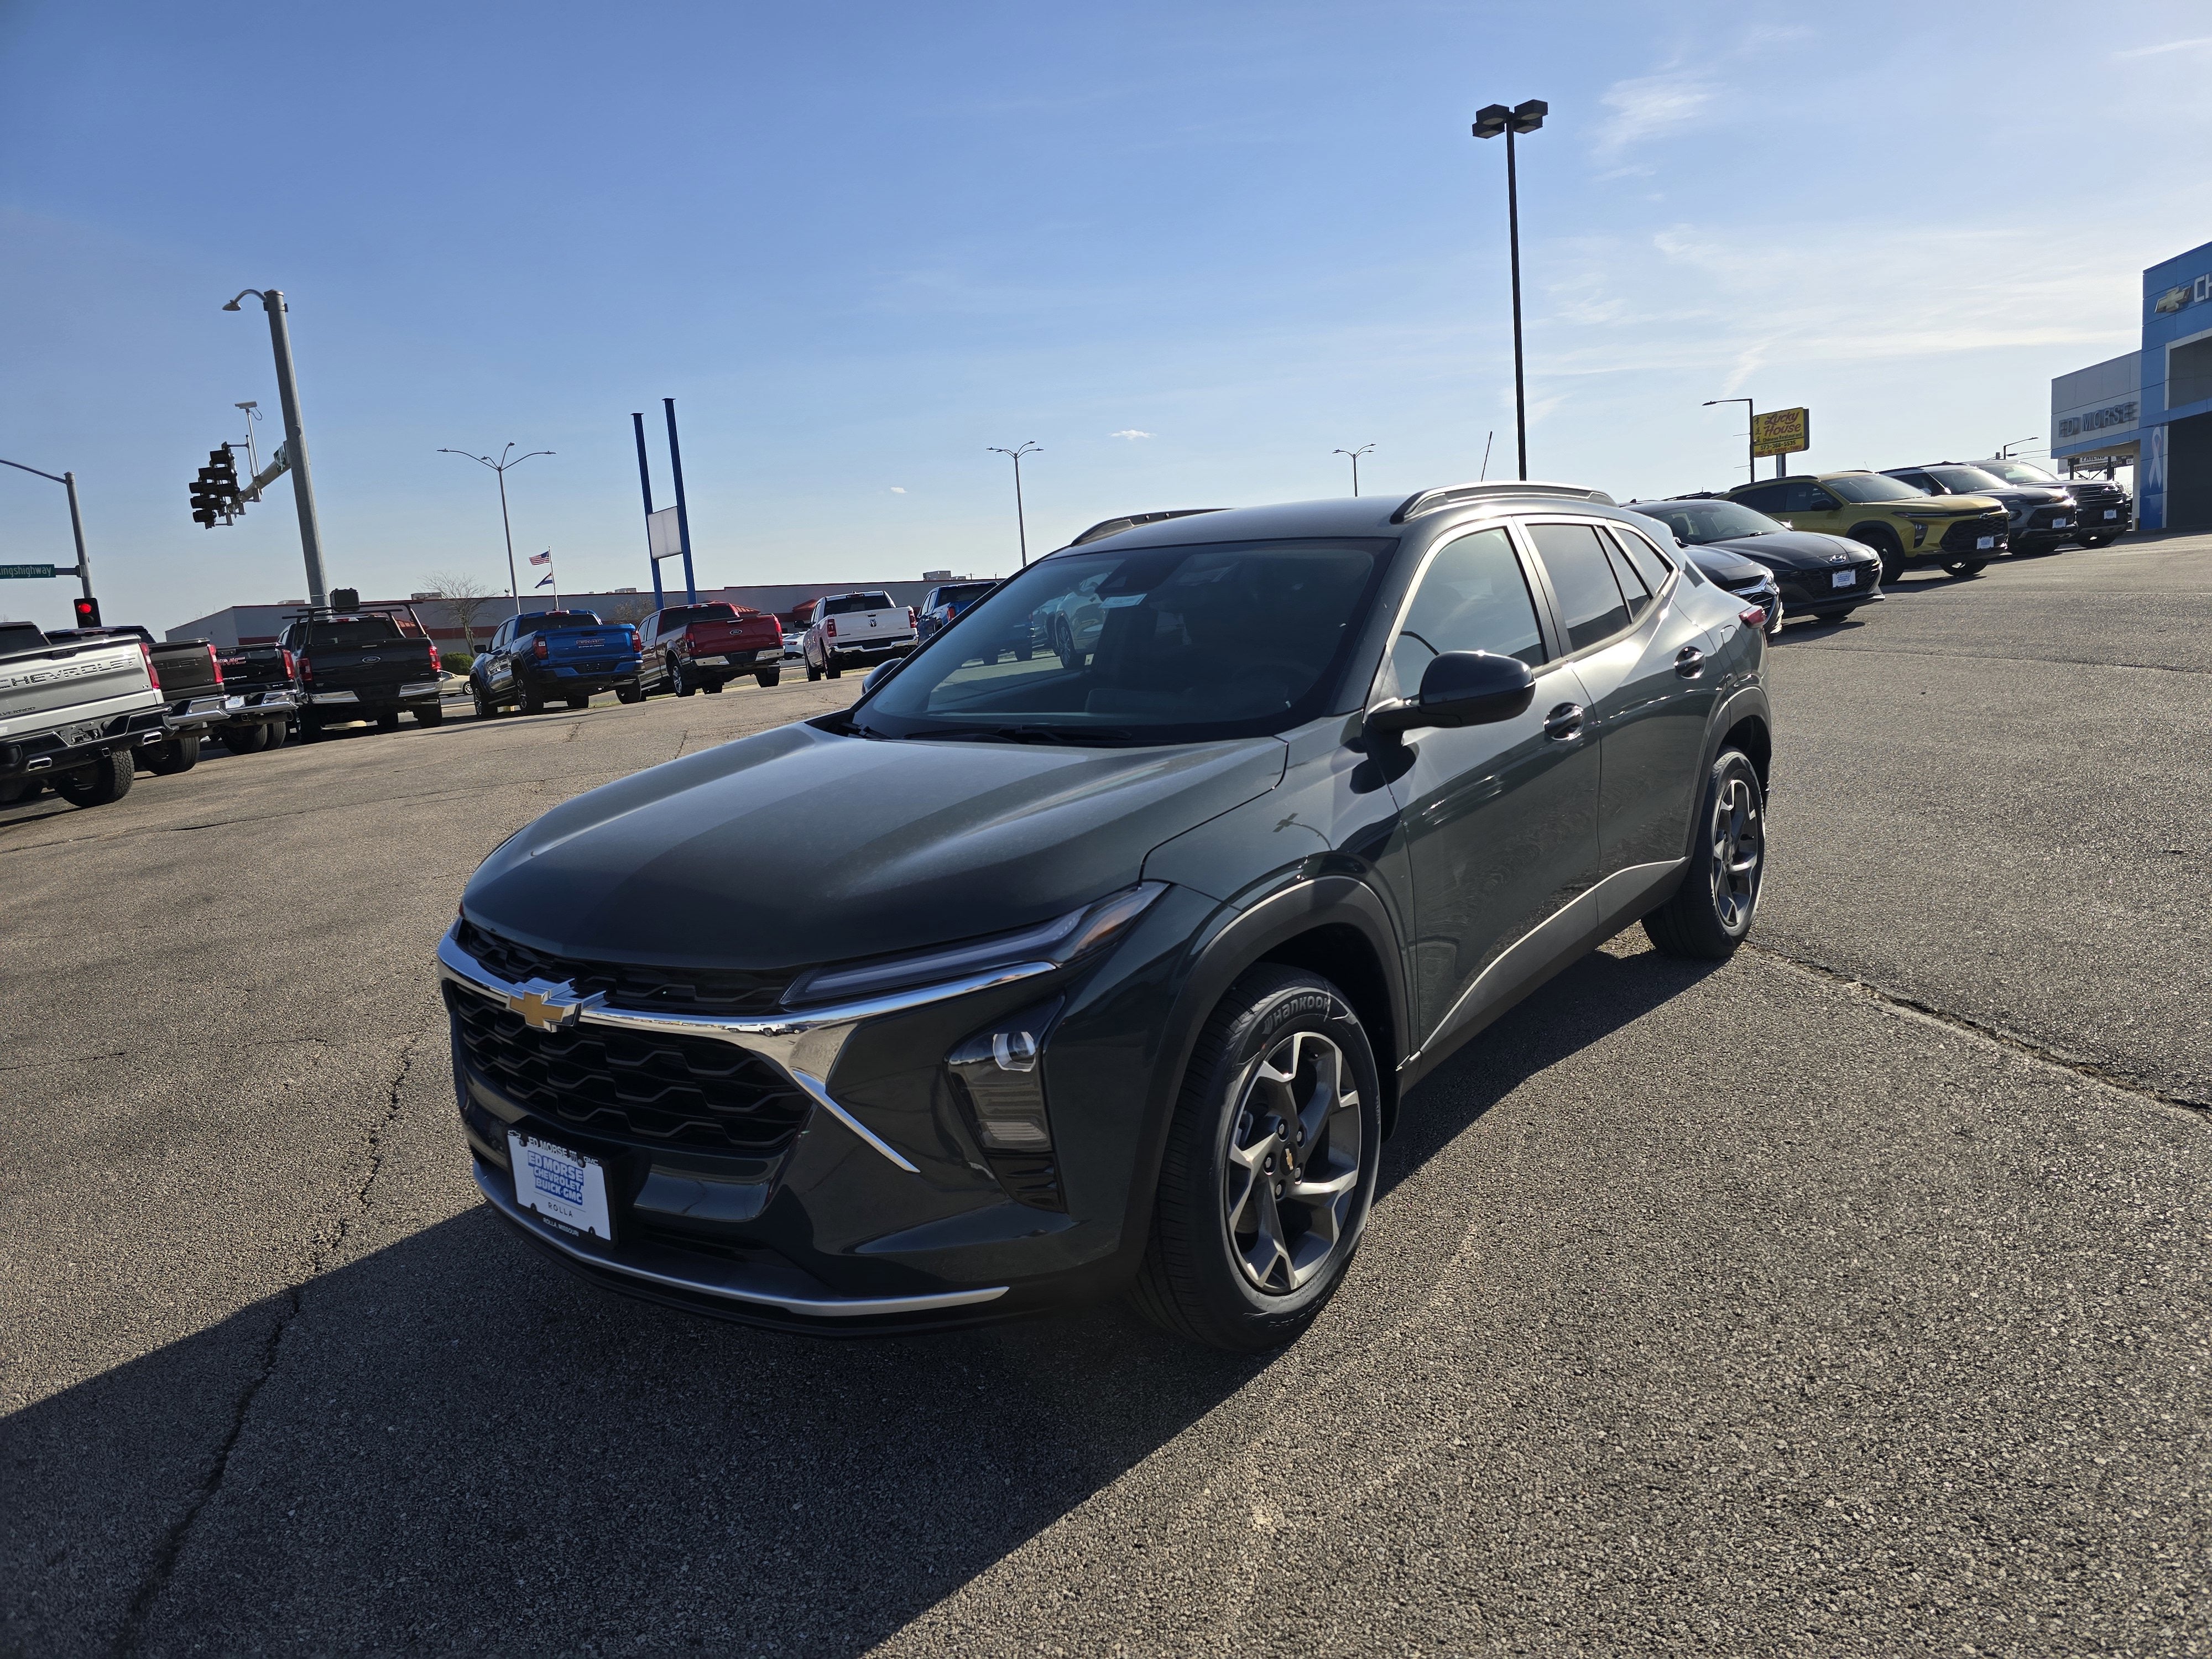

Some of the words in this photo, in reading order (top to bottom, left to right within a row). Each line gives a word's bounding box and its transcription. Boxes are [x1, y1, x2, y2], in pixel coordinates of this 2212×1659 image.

[1765, 411, 1799, 425] Lucky
[2058, 418, 2078, 437] ED
[2083, 402, 2136, 431] MORSE
[1764, 424, 1801, 437] House
[0, 565, 51, 577] ingshighway
[528, 1136, 539, 1147] ED
[540, 1140, 567, 1157] MORSE
[583, 1156, 599, 1166] GMC
[528, 1151, 542, 1167] ED
[543, 1156, 583, 1183] MORSE
[548, 1202, 573, 1218] ROLLA
